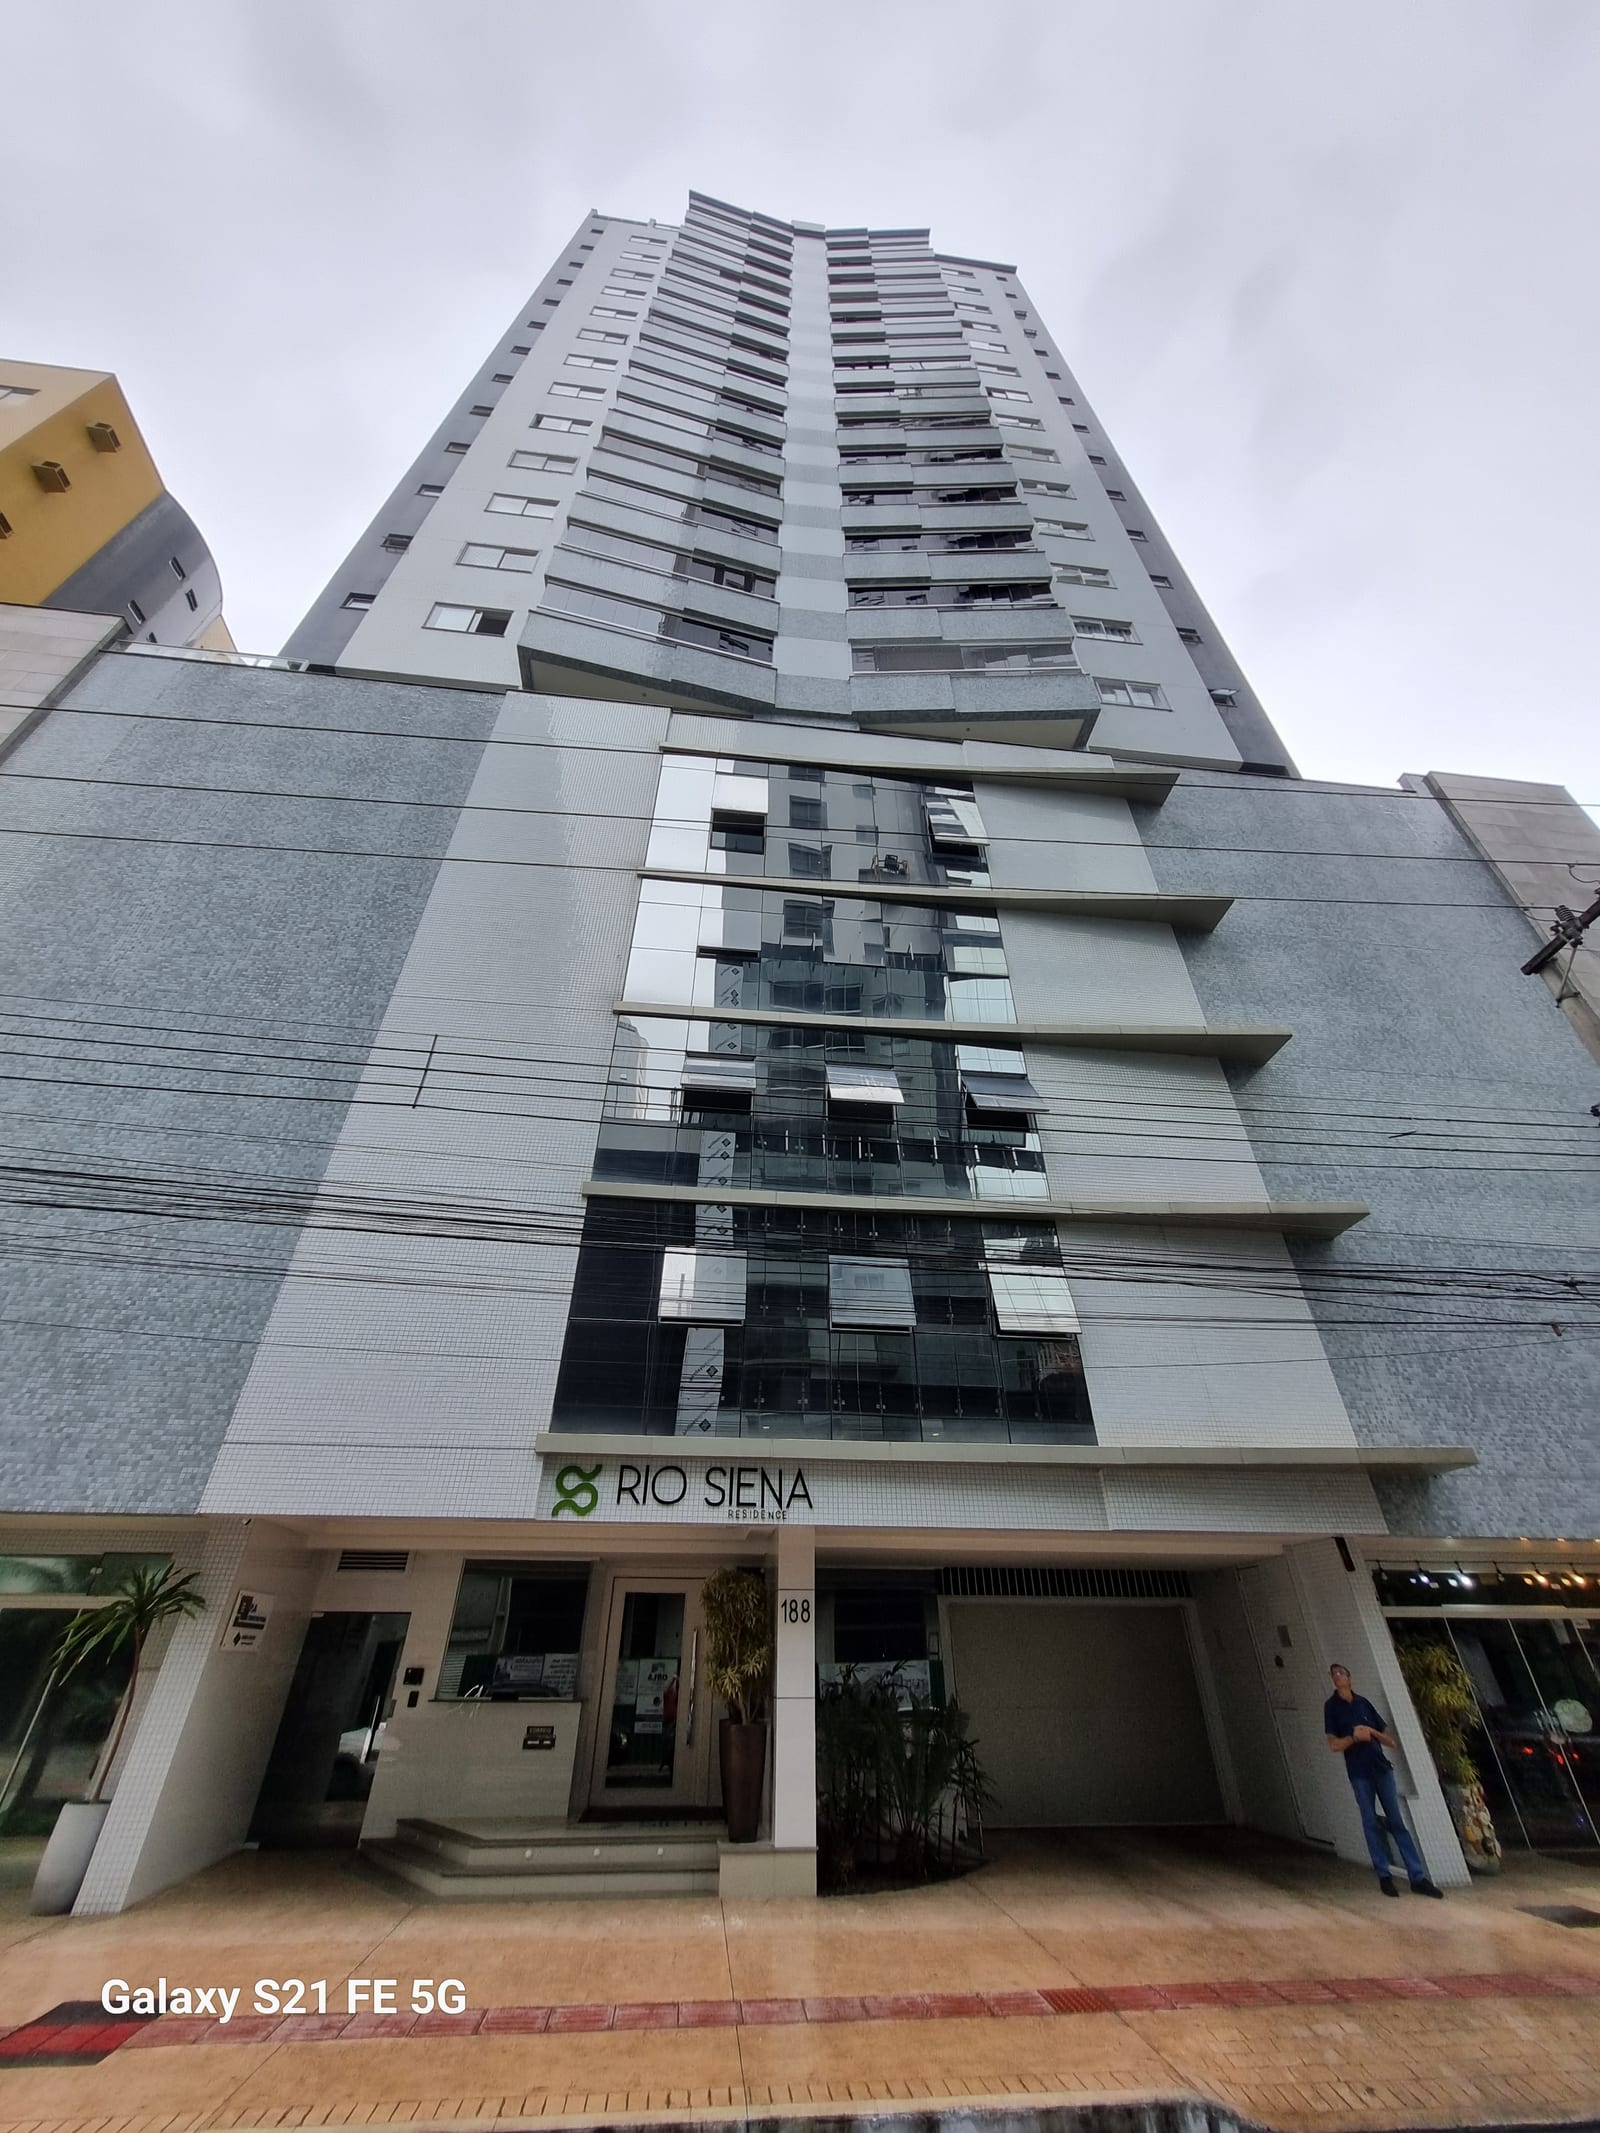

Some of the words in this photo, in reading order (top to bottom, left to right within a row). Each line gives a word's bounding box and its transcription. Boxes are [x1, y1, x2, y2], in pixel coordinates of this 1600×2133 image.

[616, 1464, 688, 1506] RIO
[704, 1466, 813, 1510] SIENA
[727, 1509, 788, 1520] RESIDENCE
[780, 1598, 811, 1624] 188
